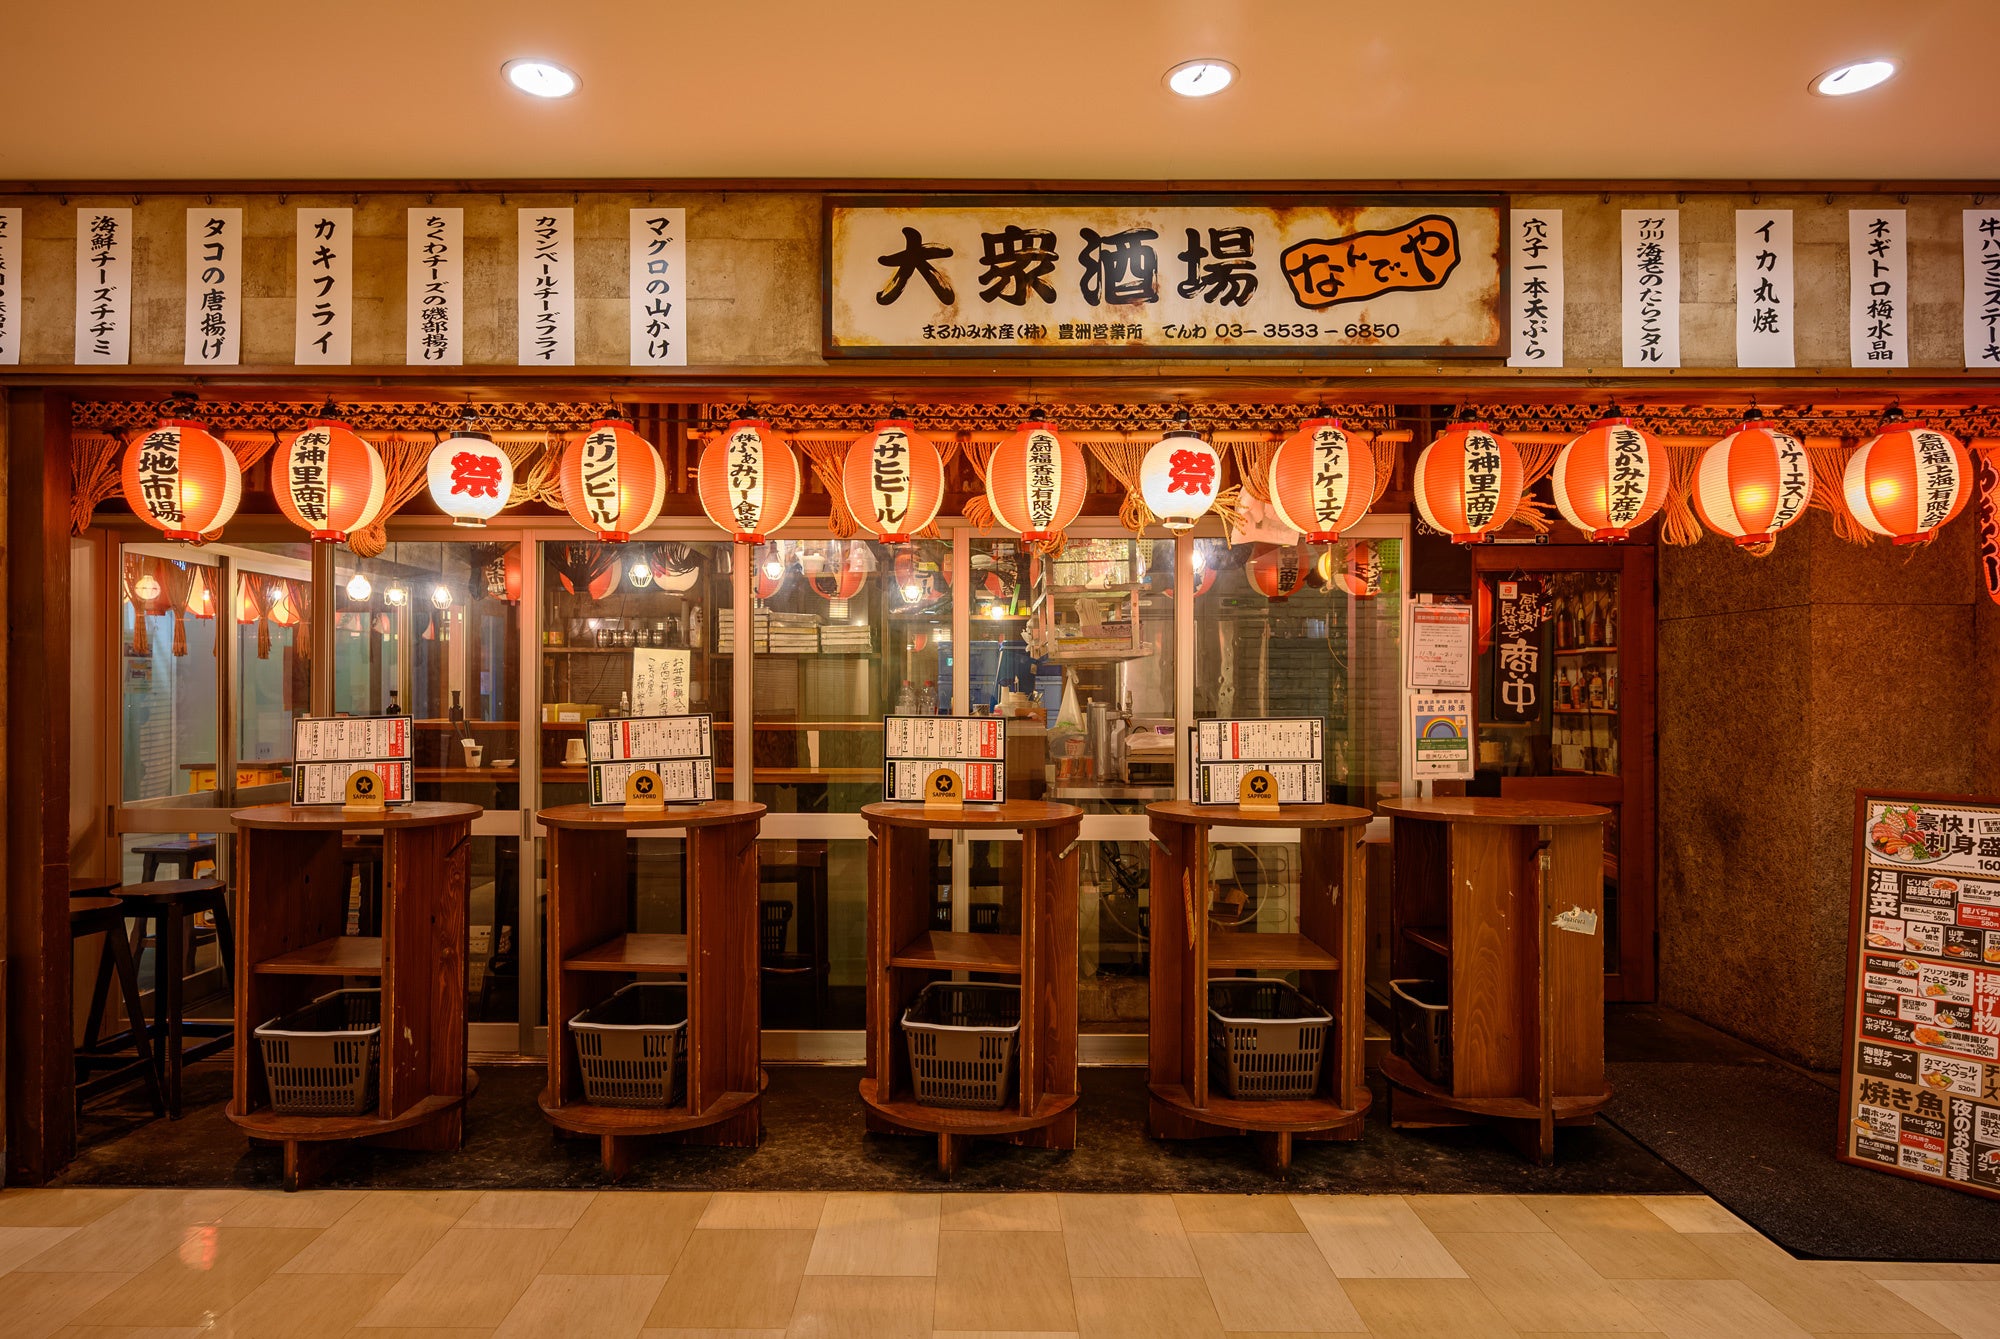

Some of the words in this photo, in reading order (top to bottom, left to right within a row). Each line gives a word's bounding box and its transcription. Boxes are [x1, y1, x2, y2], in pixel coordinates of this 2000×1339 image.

[199, 217, 227, 360] タコの唐揚げ
[311, 217, 337, 356] カキフライ
[420, 215, 449, 361] ちくわチーズの磯部揚げ
[533, 215, 559, 361] カマンベールチーズフライ
[645, 216, 671, 360] マグロの山かけ
[875, 225, 1261, 308] 大衆酒場
[1522, 217, 1551, 360] 穴子一本天ぷら
[1752, 219, 1781, 336] イカ丸焼
[1866, 217, 1896, 360] ネギトロ梅水晶
[921, 322, 1048, 341] まるかみ水産(株)
[1057, 322, 1143, 341] 豊洲営業所
[1161, 322, 1207, 341] でんわ
[138, 430, 185, 523] 築地市場
[450, 451, 503, 500] 祭
[584, 432, 621, 524] キリンビール
[873, 432, 909, 523] アサヒビール
[1166, 448, 1216, 496] 祭
[1869, 870, 1900, 917] 温菜
[1858, 1077, 1946, 1119] 焼き魚
[1948, 1098, 1974, 1182] 夜のお食事
